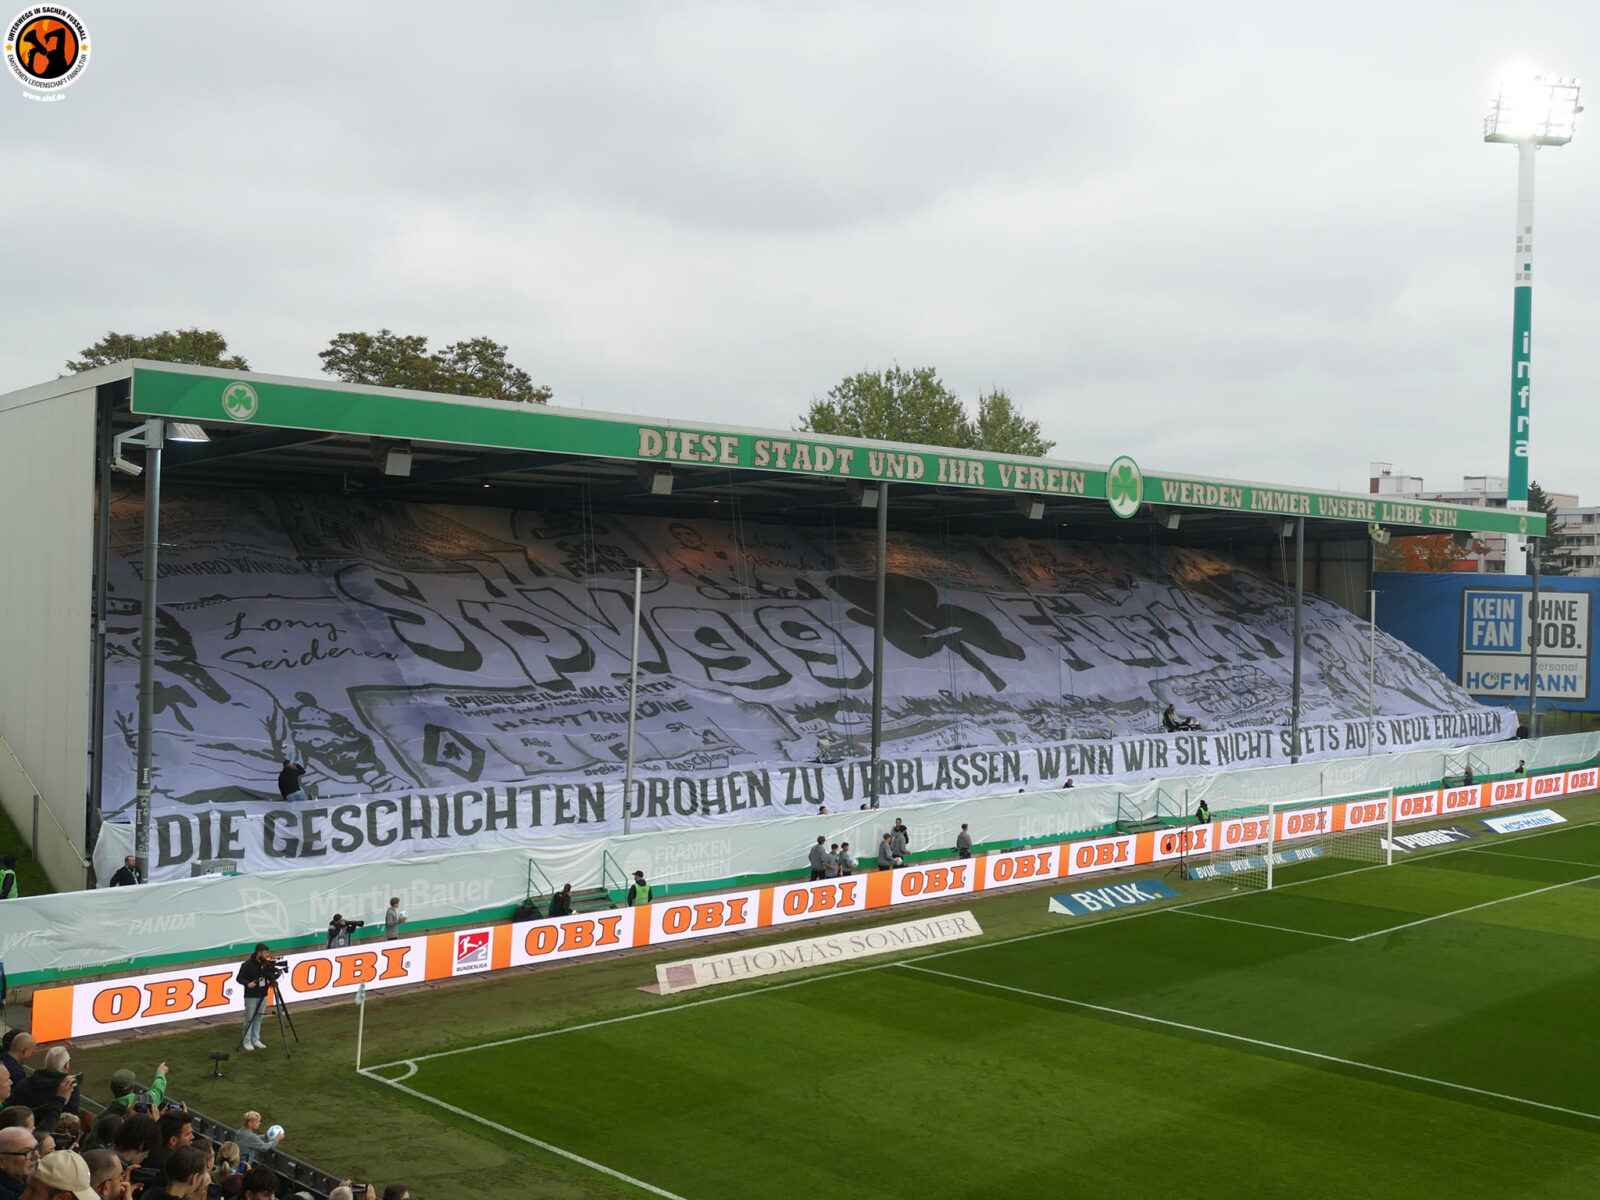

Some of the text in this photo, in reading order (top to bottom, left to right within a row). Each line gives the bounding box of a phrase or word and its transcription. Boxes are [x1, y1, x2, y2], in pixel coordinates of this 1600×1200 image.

[638, 427, 1459, 528] DIESE STADT UND IHR VEREIN WERDEN IMMER UNSERE LIEBE SEIN
[1472, 597, 1515, 620] KEIN
[1472, 620, 1515, 647] FAN
[1527, 622, 1582, 649] JOB.
[1535, 662, 1579, 672] ersonal
[152, 808, 247, 869] DIE
[262, 781, 607, 860] GESCHICHTEN
[620, 767, 773, 819] DROHEN
[778, 765, 826, 806] ZU
[836, 749, 1029, 801] VERBLASSEN,
[1036, 743, 1114, 781] WENN
[1118, 737, 1169, 773] WIR
[1175, 734, 1208, 767] SIE
[1213, 729, 1274, 767] NICHT
[1389, 716, 1431, 745] NEUE
[1495, 782, 1524, 801] OBI
[1535, 777, 1561, 794] OBI
[1571, 772, 1595, 788] OBI
[1401, 796, 1434, 816] OBI
[1447, 789, 1478, 809] OBI
[1287, 810, 1327, 835] OBI
[1350, 801, 1387, 826] OBI
[655, 839, 732, 862] FRANKEN
[1076, 840, 1130, 869] OBI
[1160, 829, 1208, 856] OBI
[901, 864, 967, 897] OBI
[993, 852, 1052, 882] OBI
[783, 881, 857, 917] OBI
[662, 897, 749, 935] OBI
[525, 915, 622, 956] OBI
[702, 916, 973, 981] THOMAS SOMMER
[291, 946, 411, 993] OBI
[456, 963, 488, 972] BUNDESLIGA
[92, 971, 233, 1024] OBI
